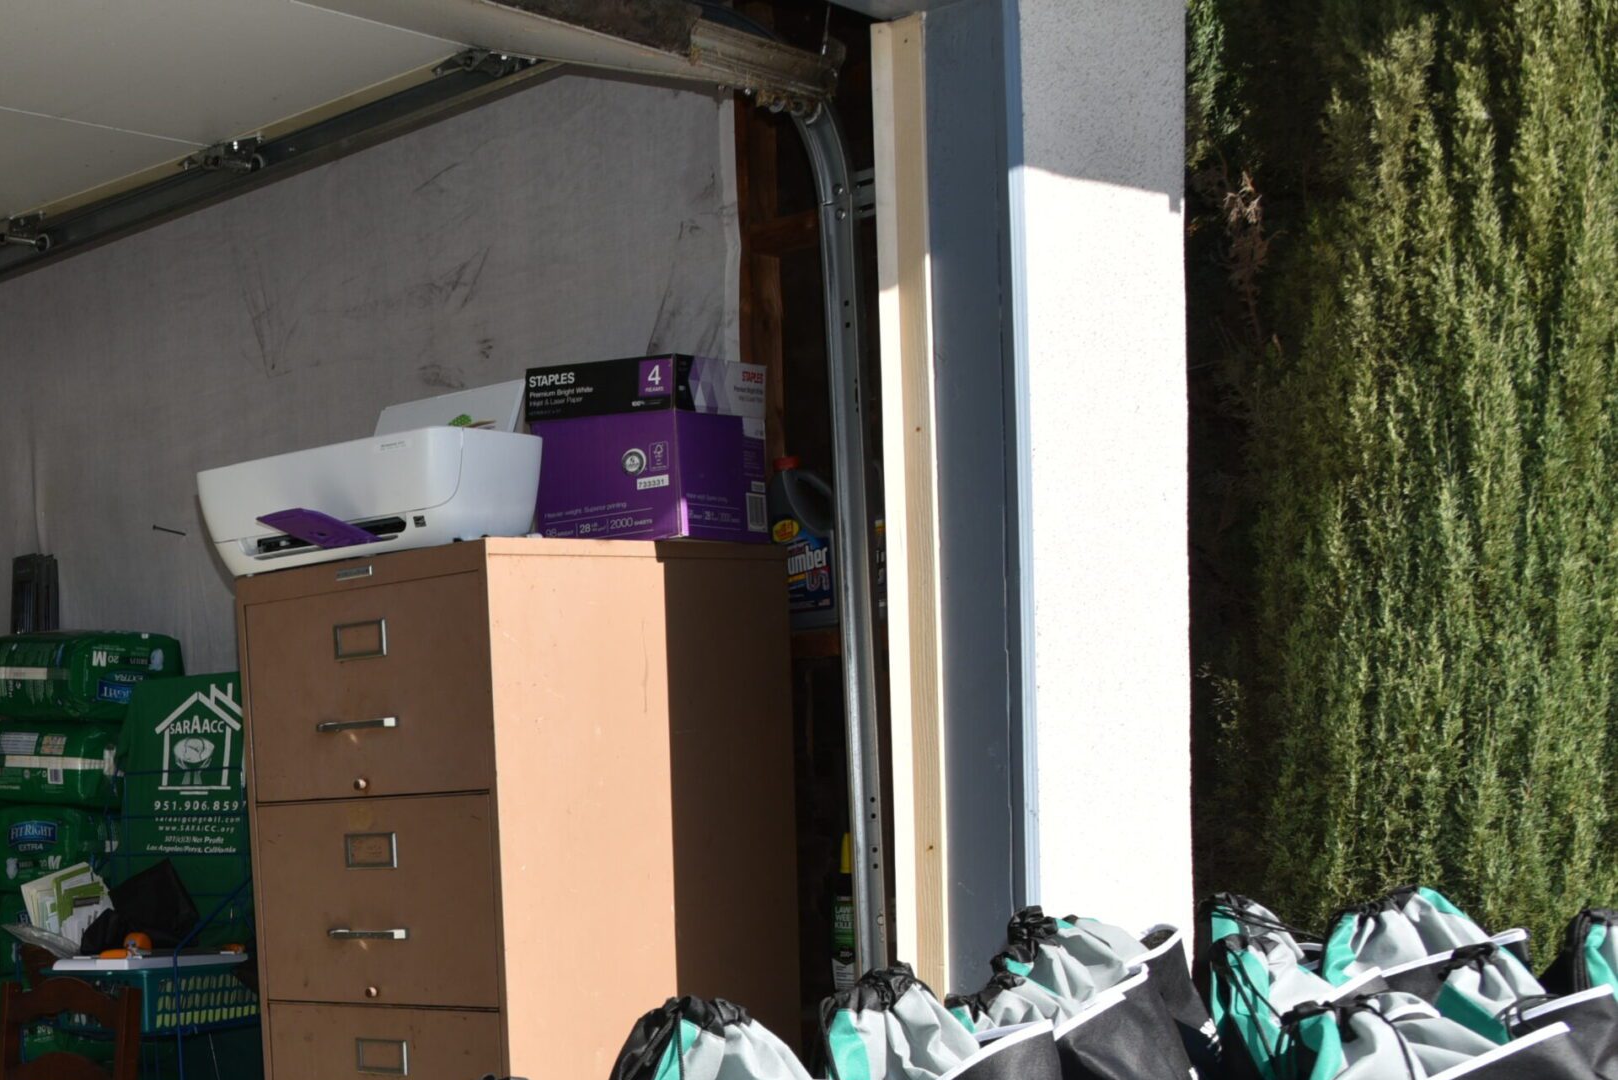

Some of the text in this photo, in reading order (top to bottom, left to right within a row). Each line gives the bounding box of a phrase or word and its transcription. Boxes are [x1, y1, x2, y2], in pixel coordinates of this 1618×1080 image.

[529, 372, 575, 388] STAPLES
[647, 364, 662, 385] 4
[742, 371, 764, 384] STAPLES
[529, 390, 556, 399] Premium
[556, 387, 575, 397] Bright
[610, 517, 633, 530] 2000
[91, 650, 119, 667] 20 M
[169, 714, 225, 735] SARAACC
[18, 843, 44, 852] EXTRA
[48, 855, 62, 870] M
